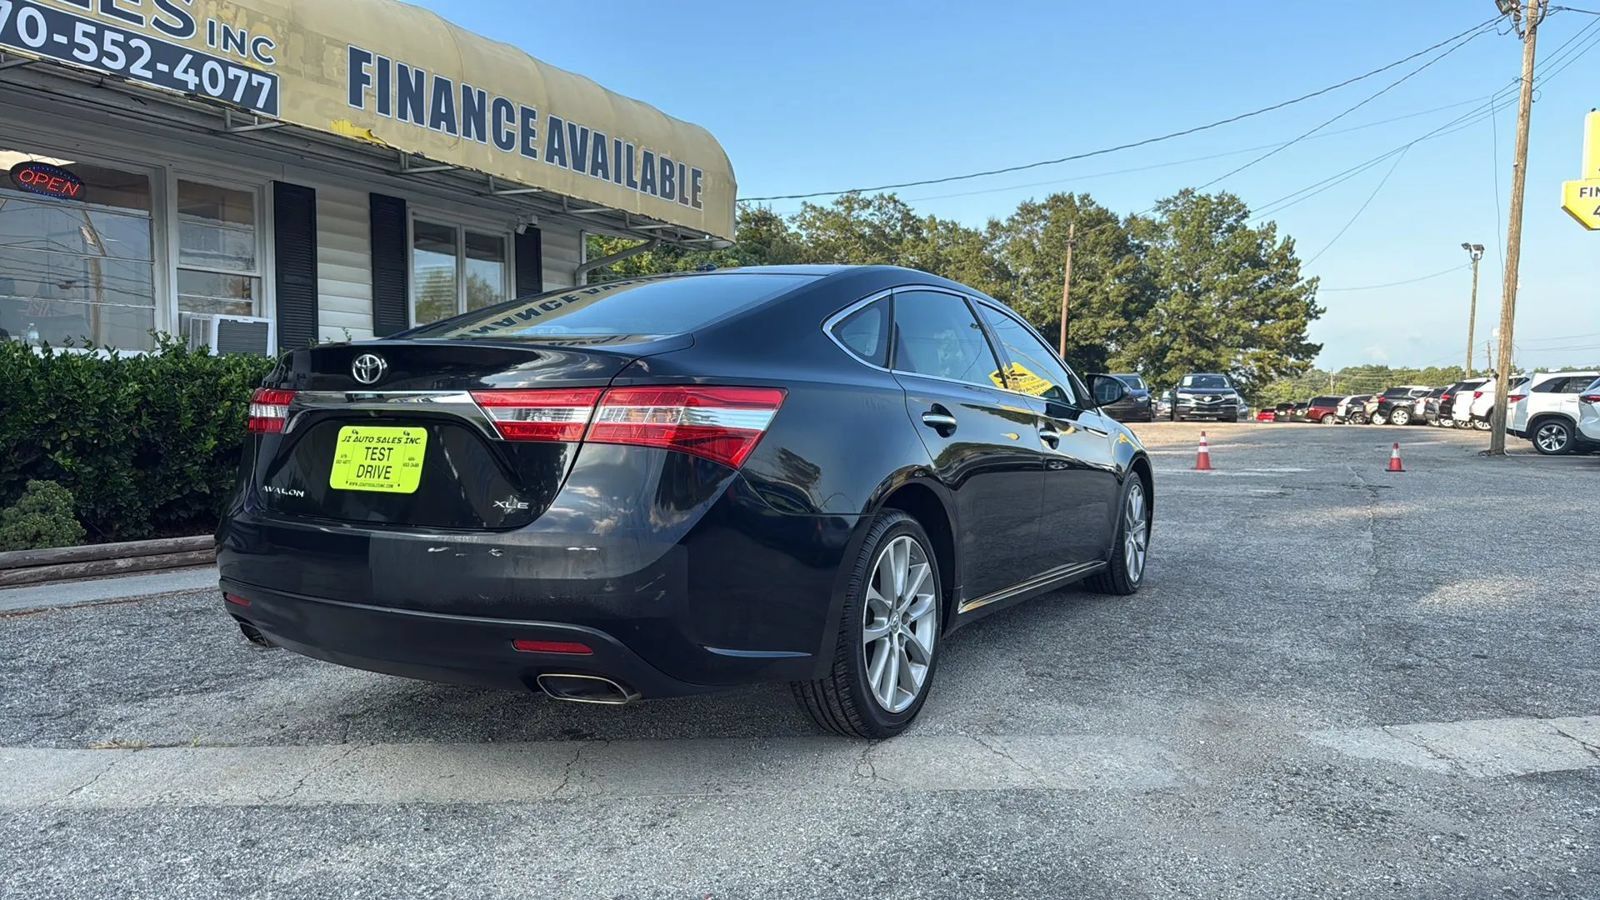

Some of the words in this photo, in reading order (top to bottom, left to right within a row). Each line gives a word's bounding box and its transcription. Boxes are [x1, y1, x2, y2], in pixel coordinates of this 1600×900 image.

[207, 18, 276, 66] INC
[347, 43, 538, 160] FINANCE
[545, 113, 703, 210] AVAILABLE
[19, 169, 80, 196] OPEN
[353, 436, 375, 444] AUTO
[375, 436, 402, 445] SALES
[364, 446, 394, 462] TEST
[356, 464, 392, 480] DRIVE
[261, 485, 305, 498] AVALON
[492, 500, 529, 510] XLE
